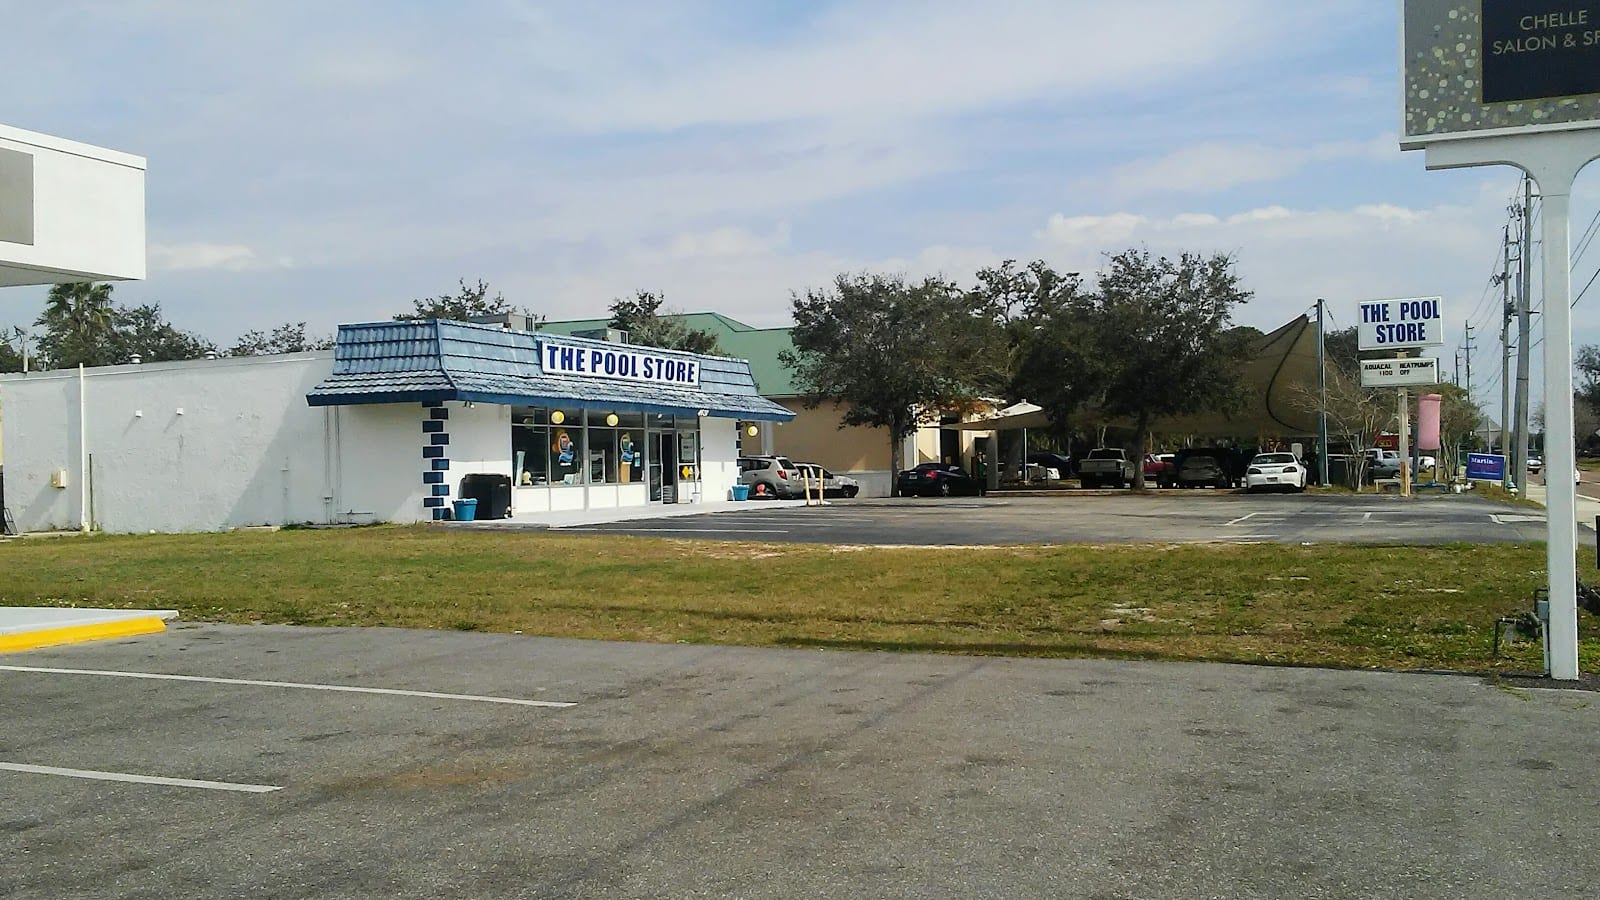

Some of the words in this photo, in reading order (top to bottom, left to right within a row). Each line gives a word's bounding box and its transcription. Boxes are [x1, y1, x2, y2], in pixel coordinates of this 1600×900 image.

[1520, 9, 1588, 31] CHELLE
[1492, 35, 1557, 55] SALON
[1563, 33, 1577, 48] &
[1361, 303, 1389, 323] THE
[1400, 300, 1440, 320] POOL
[1376, 322, 1426, 343] STORE
[546, 345, 586, 372] THE
[591, 350, 638, 377] POOL
[643, 357, 695, 383] STORE
